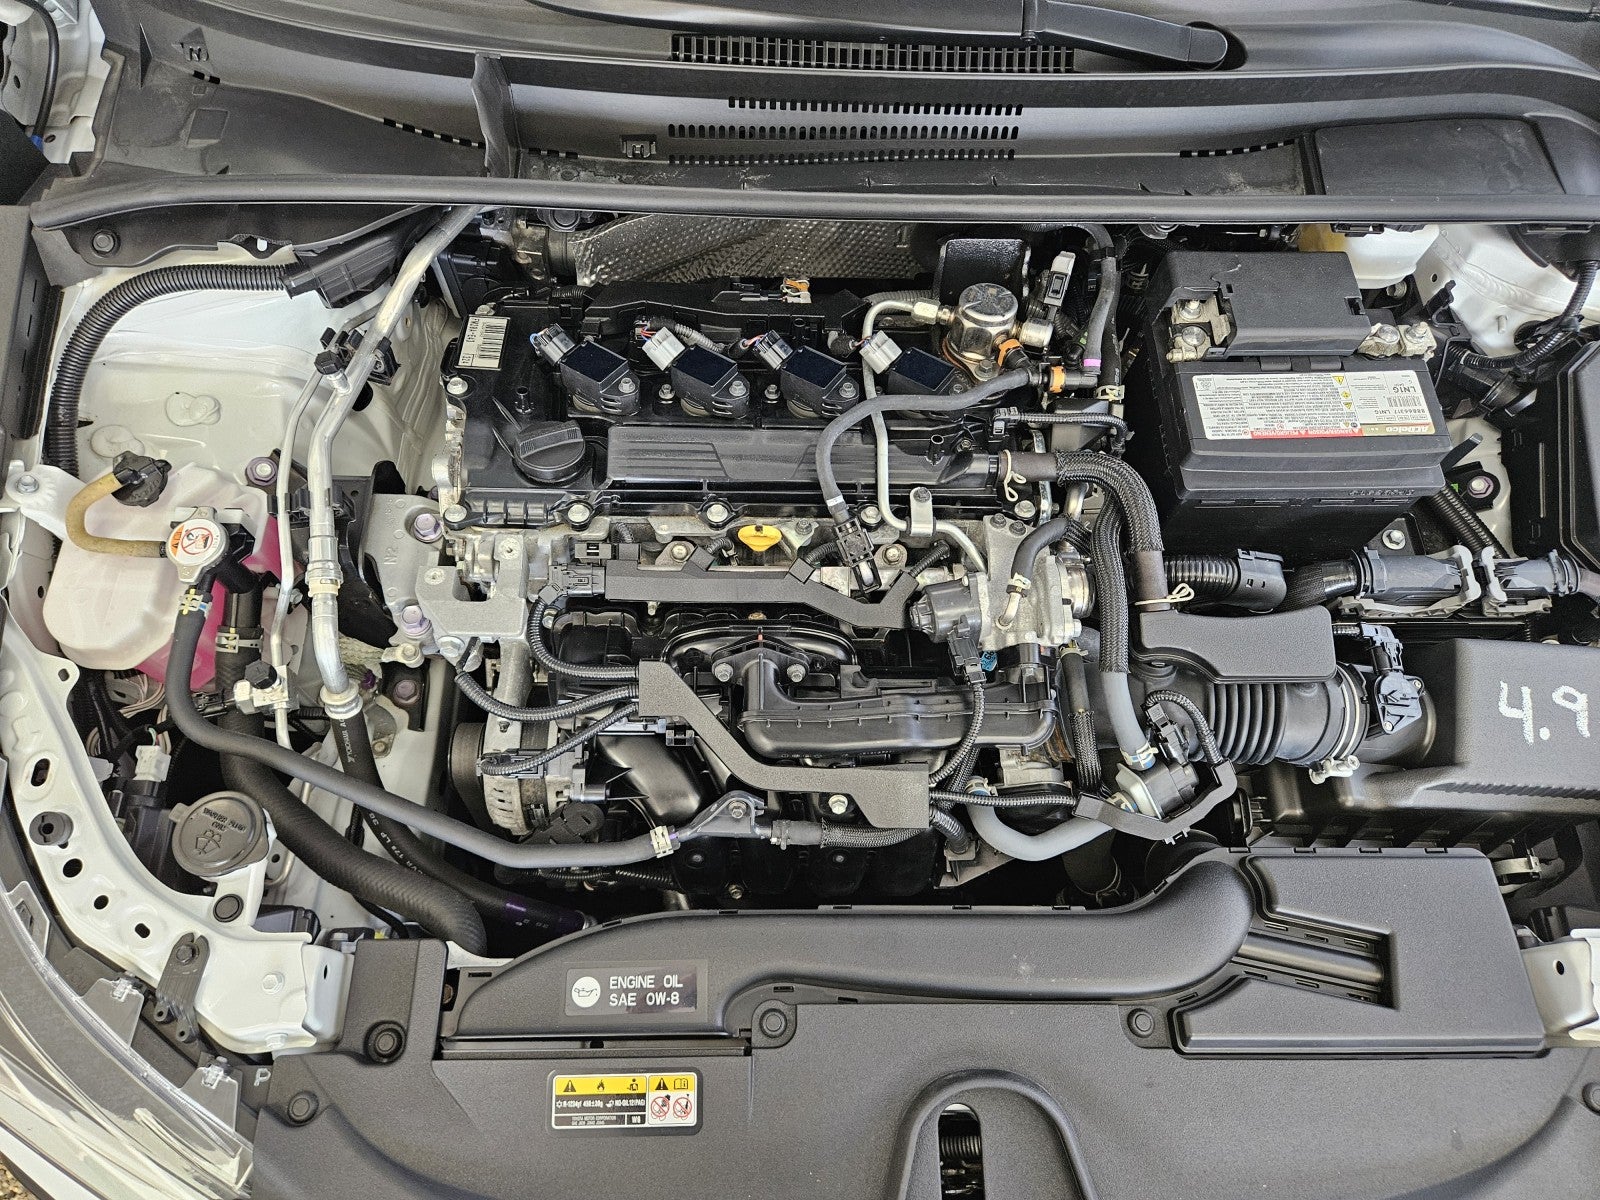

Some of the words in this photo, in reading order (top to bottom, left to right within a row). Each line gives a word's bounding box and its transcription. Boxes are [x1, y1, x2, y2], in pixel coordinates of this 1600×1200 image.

[1498, 680, 1590, 745] 4.9
[609, 975, 655, 989] ENGINE
[663, 974, 683, 988] OIL
[609, 992, 637, 1006] SAE
